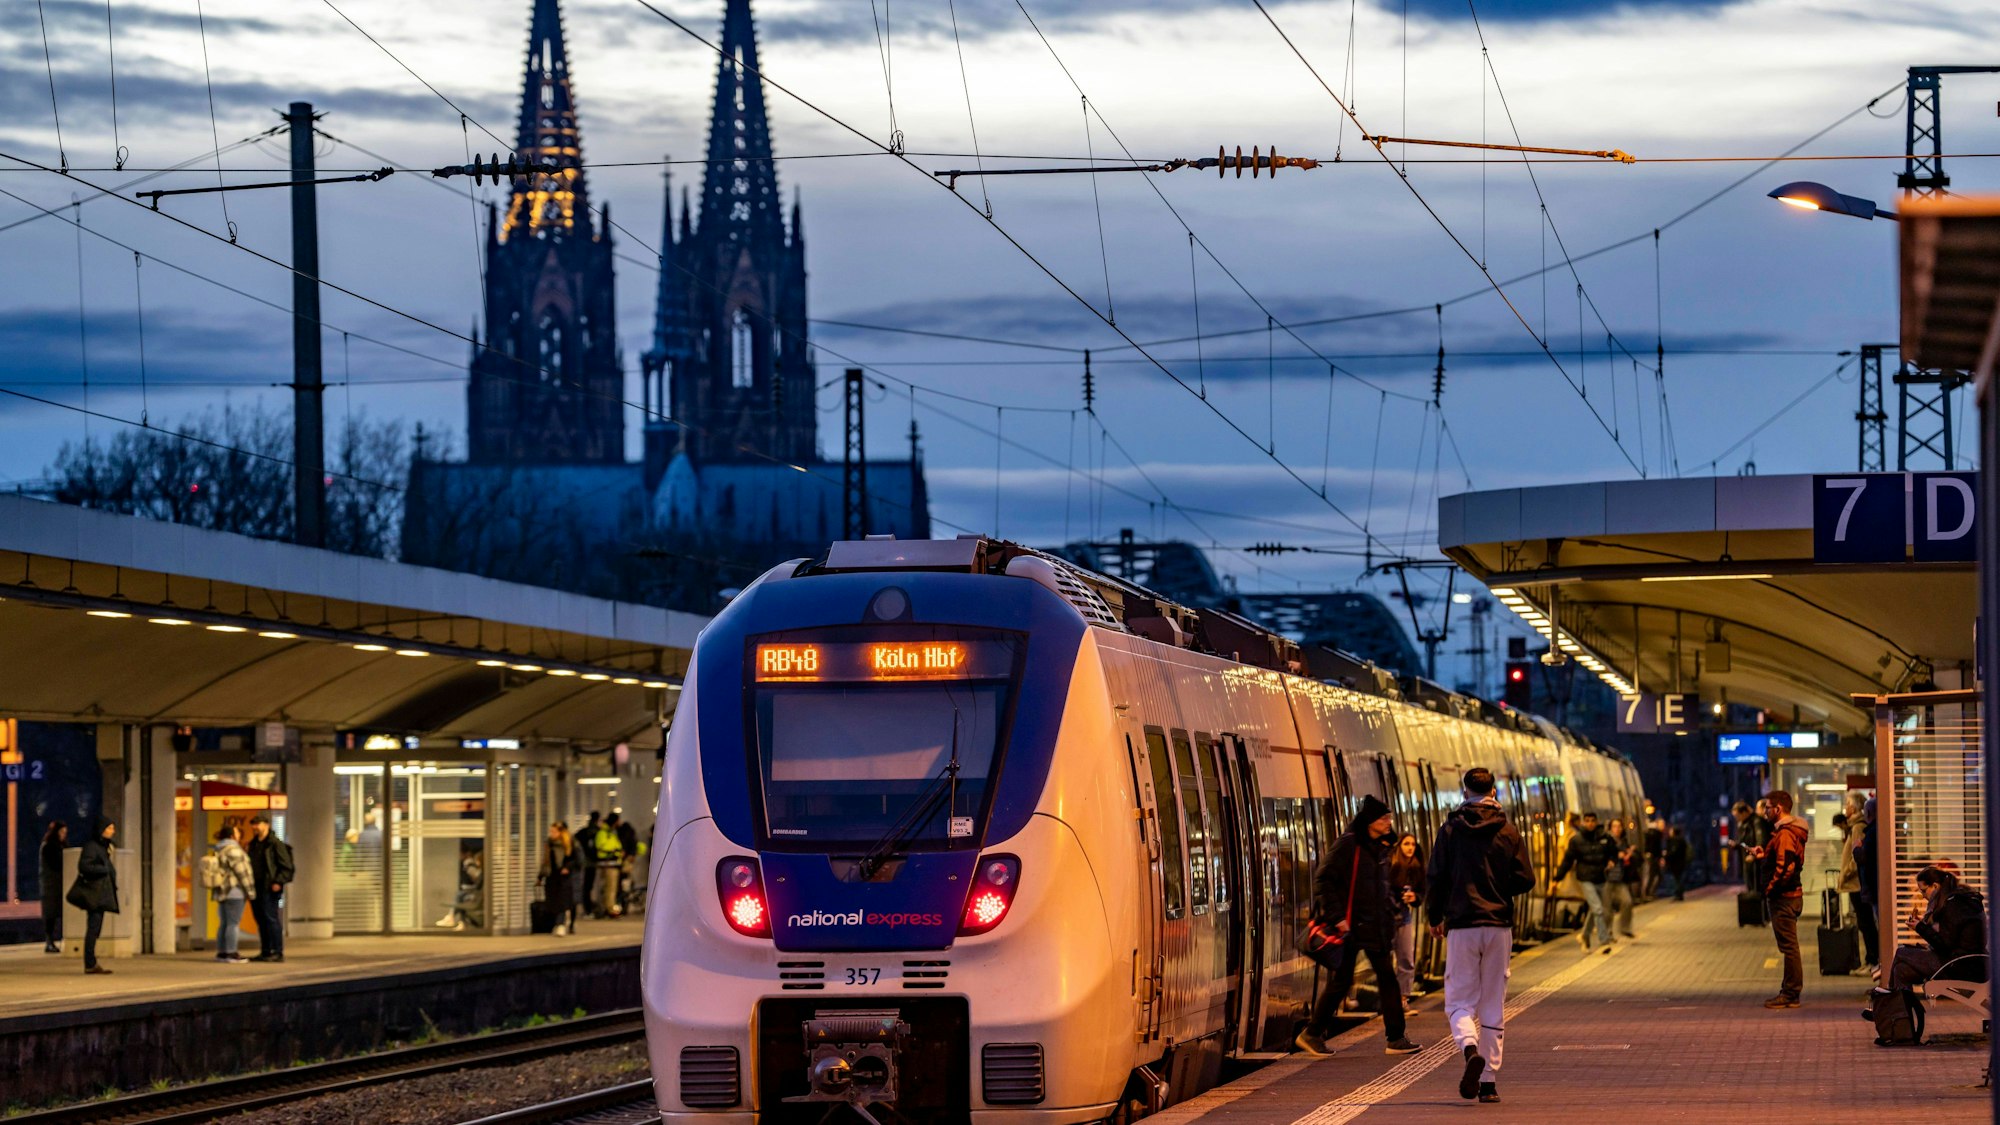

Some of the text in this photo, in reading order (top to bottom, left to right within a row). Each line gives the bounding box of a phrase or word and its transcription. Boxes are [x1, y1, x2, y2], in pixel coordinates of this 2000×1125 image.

[1825, 477, 1975, 541] 7 D
[763, 647, 957, 672] RB48 Köln Hbf
[1621, 693, 1685, 725] 7 E
[31, 759, 43, 779] 2
[222, 815, 248, 827] JOY
[788, 909, 943, 929] national express
[845, 967, 881, 985] 357
